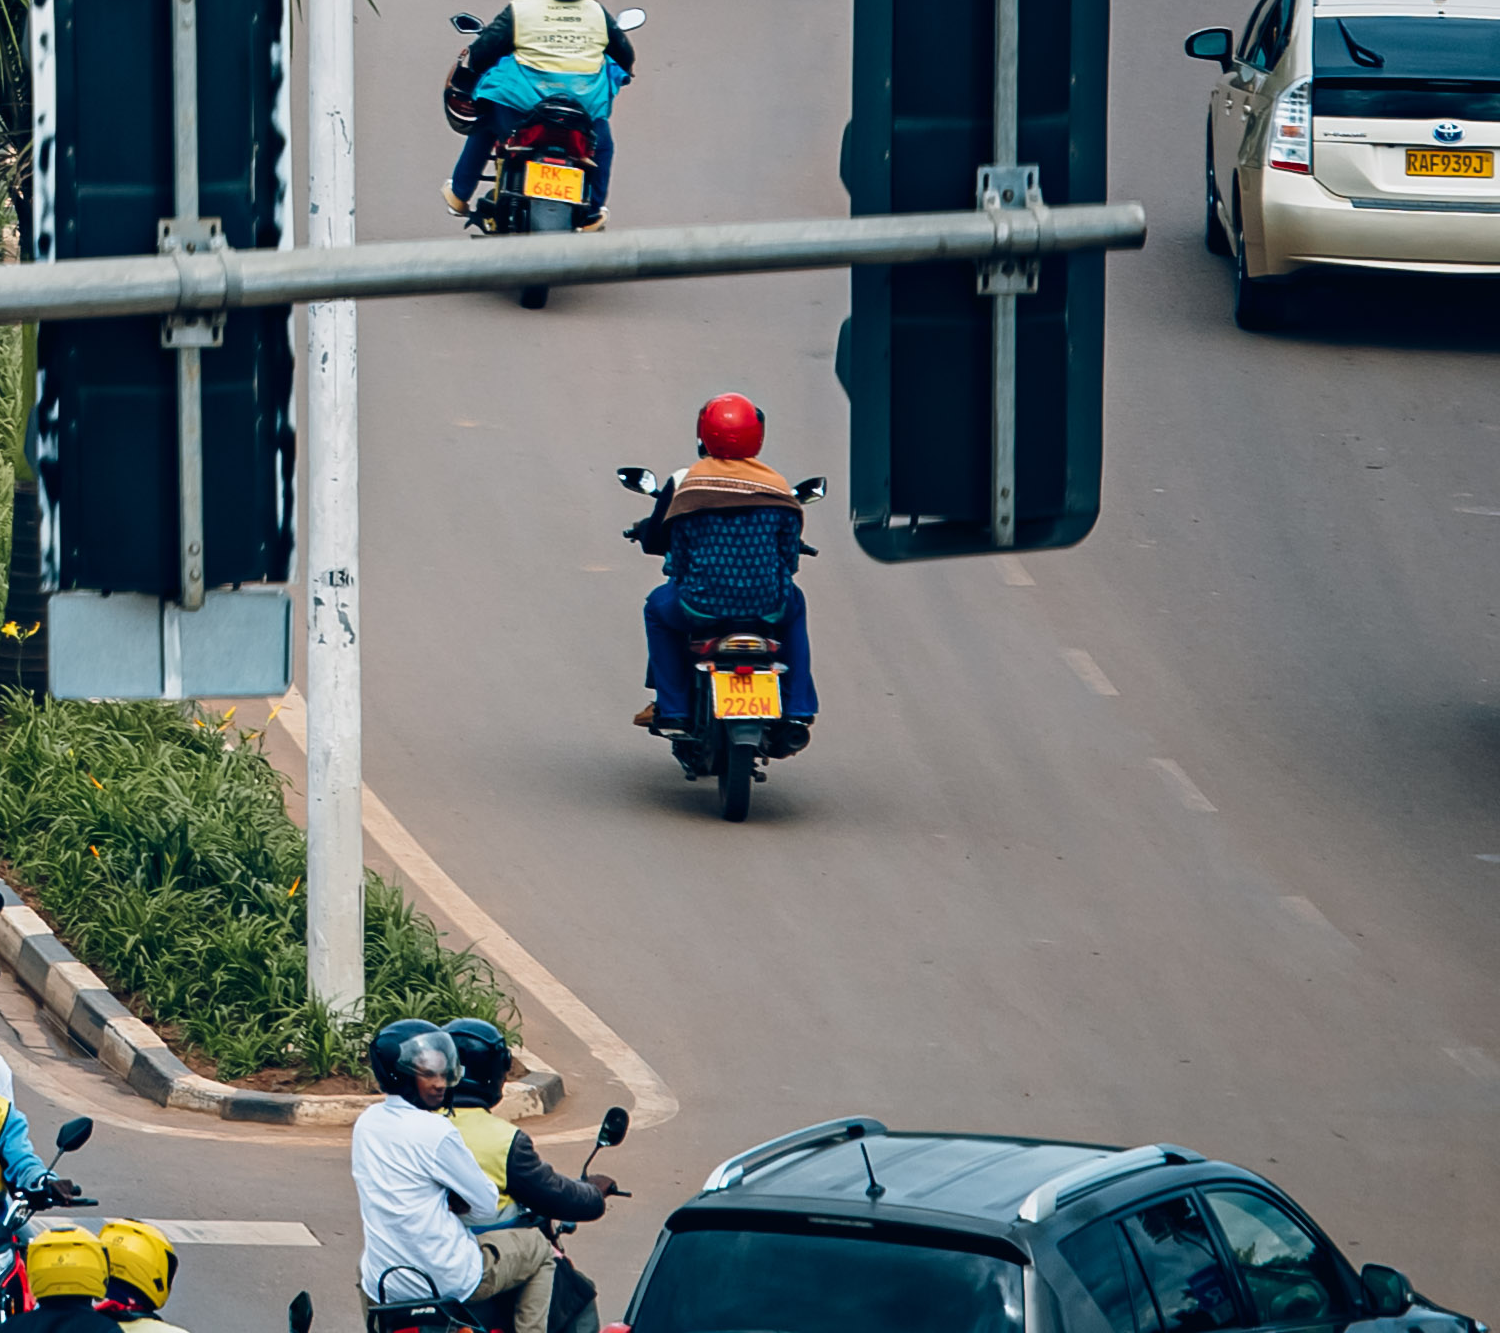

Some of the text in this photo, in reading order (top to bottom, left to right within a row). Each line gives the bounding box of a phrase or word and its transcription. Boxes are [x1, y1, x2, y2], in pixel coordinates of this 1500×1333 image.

[1407, 153, 1484, 174] RAF939J
[540, 165, 561, 182] RK
[533, 182, 574, 201] 684E
[723, 697, 771, 717] 226W
